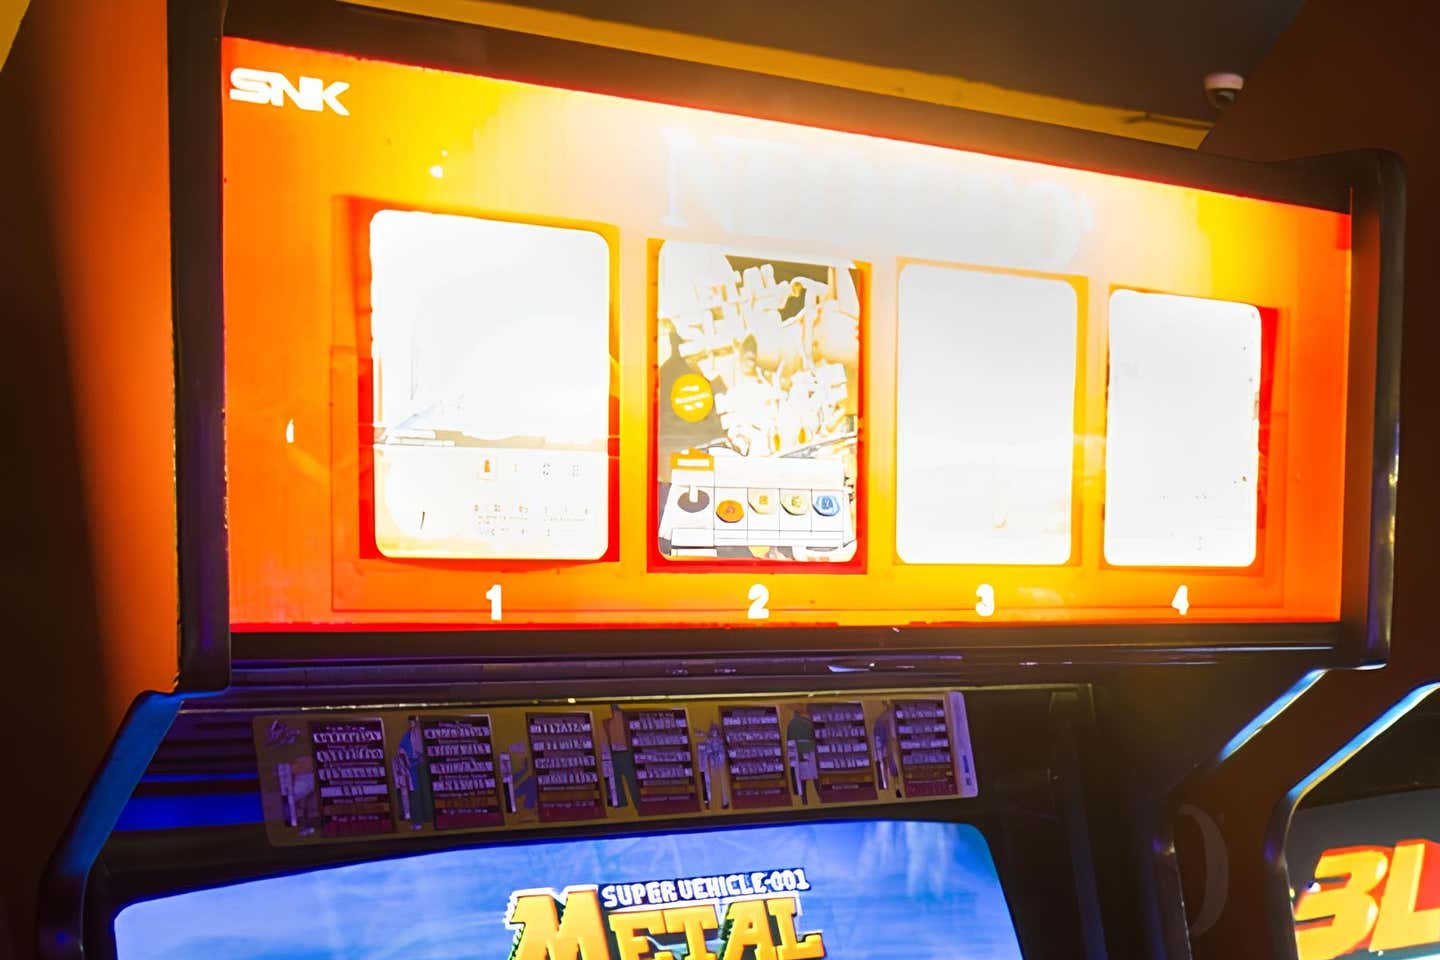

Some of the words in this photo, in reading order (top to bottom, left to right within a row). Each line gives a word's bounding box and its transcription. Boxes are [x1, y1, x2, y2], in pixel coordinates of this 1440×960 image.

[229, 67, 351, 117] SNK
[486, 583, 503, 620] 1
[747, 583, 769, 619] 2
[975, 584, 995, 617] 3
[1171, 585, 1190, 616] 4
[603, 876, 679, 907] SUPER
